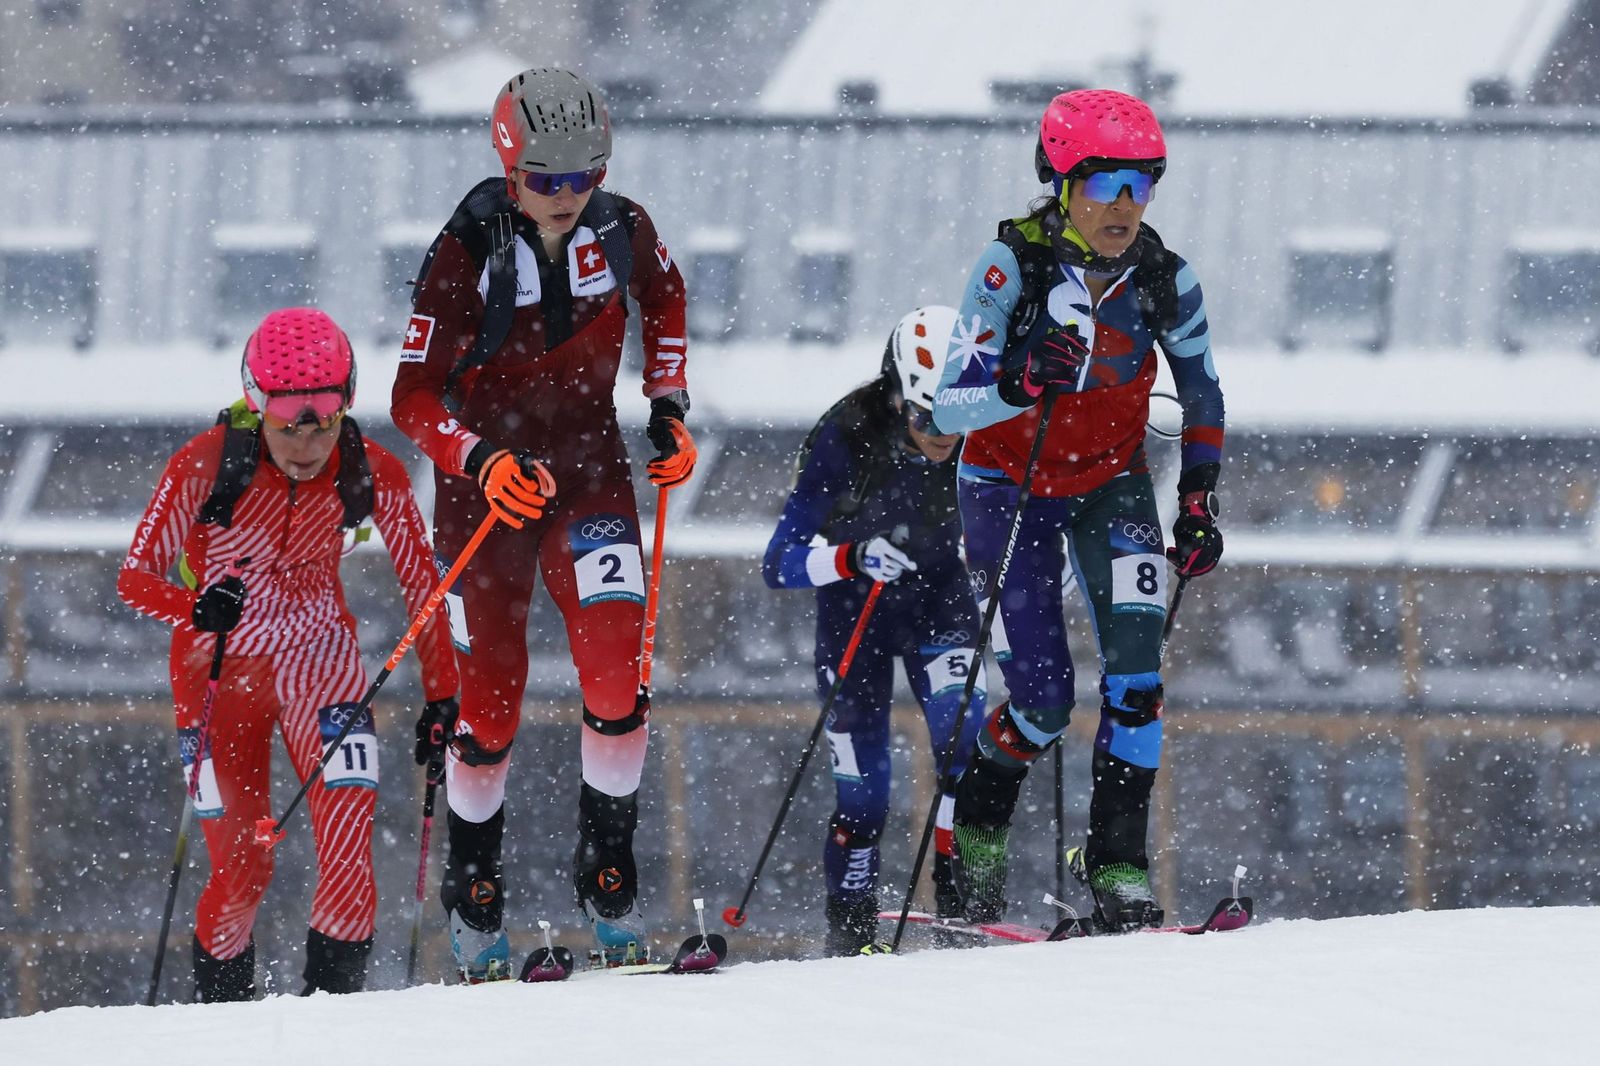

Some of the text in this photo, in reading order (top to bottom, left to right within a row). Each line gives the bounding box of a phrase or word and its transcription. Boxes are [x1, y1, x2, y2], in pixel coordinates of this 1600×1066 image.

[133, 477, 173, 556] MARTINI
[598, 553, 626, 585] 2
[1136, 561, 1158, 596] 8
[947, 655, 969, 677] 5
[340, 742, 367, 771] 11
